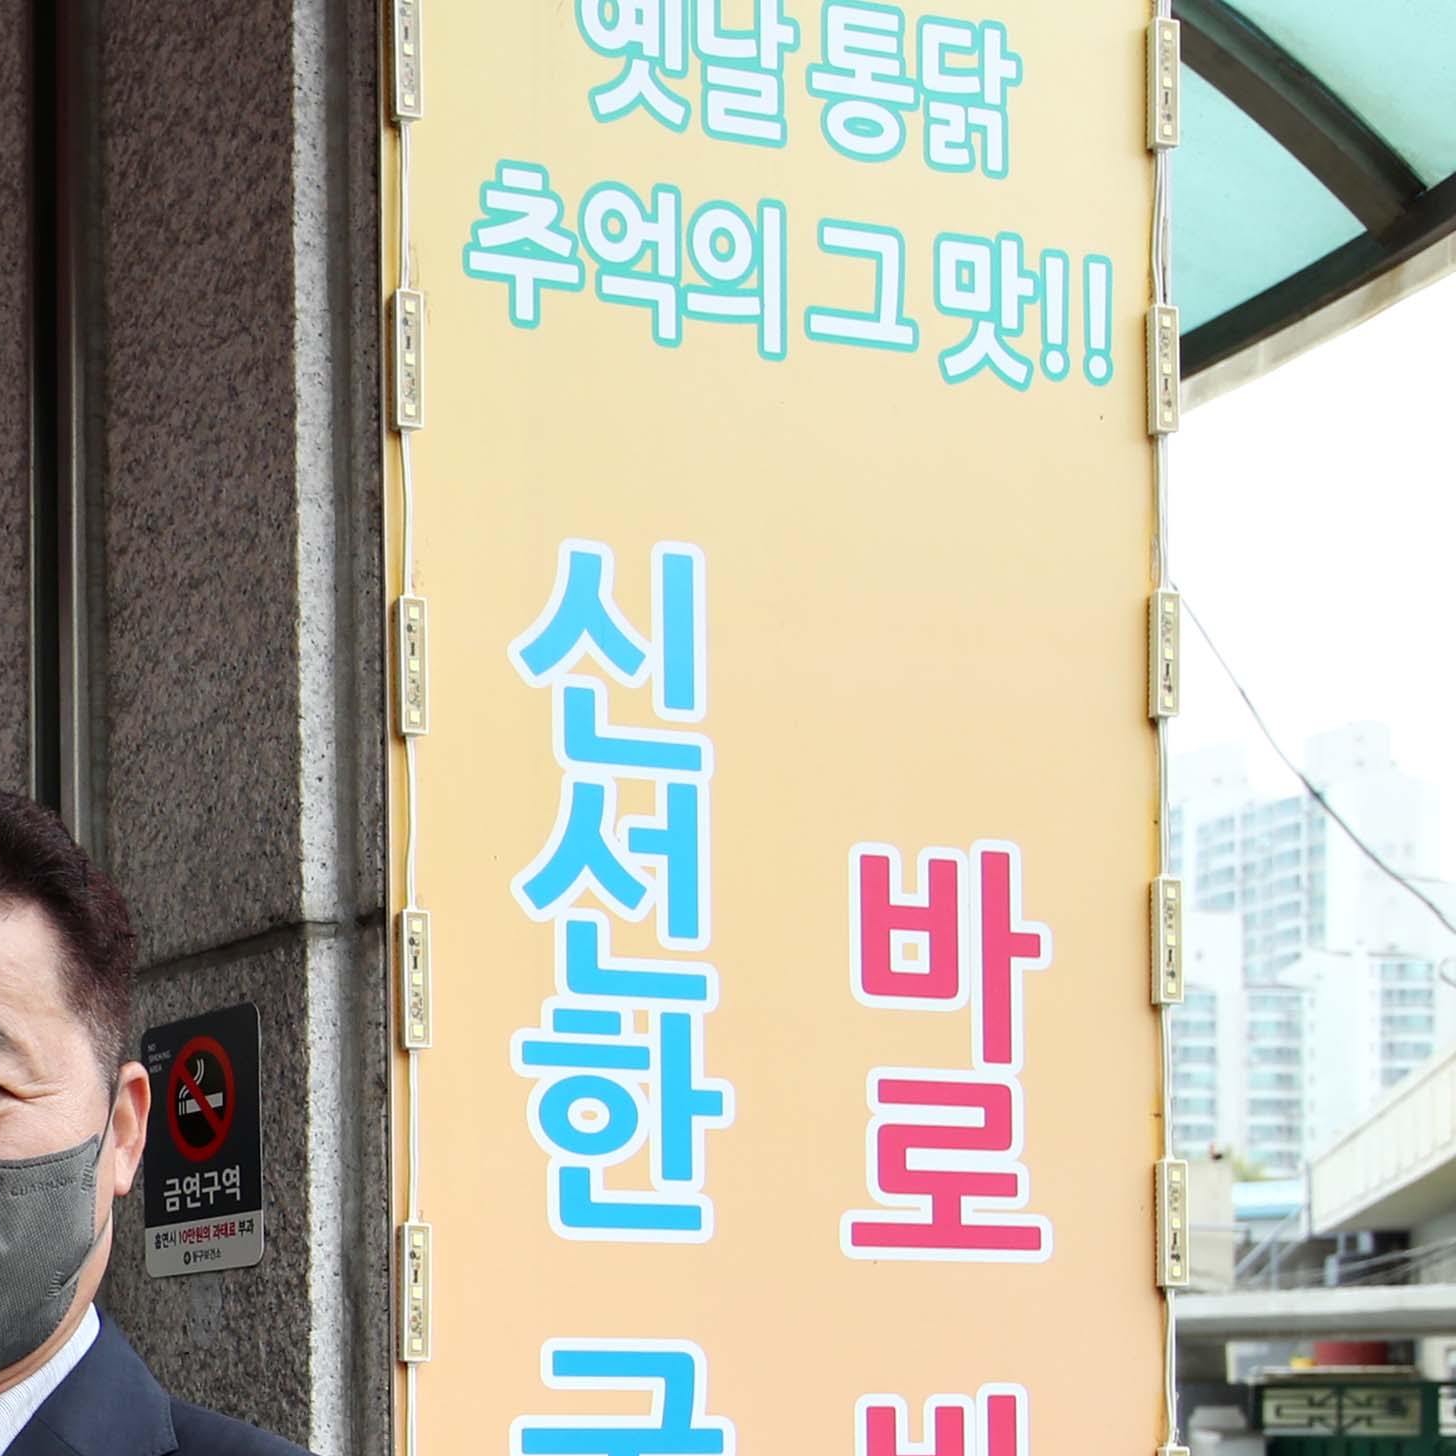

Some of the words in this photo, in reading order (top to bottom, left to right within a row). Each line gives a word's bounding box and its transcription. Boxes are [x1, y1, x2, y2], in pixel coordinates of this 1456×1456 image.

[575, 0, 798, 149] 옛날
[808, 0, 1022, 179] 통닭
[463, 159, 788, 362] 추억의
[805, 218, 918, 353] 그
[932, 230, 1113, 391] 맛!!
[508, 537, 735, 1242] 신선한
[840, 838, 1053, 1262] 바로
[163, 1164, 241, 1213] 금연구역
[238, 1218, 255, 1239] 부과
